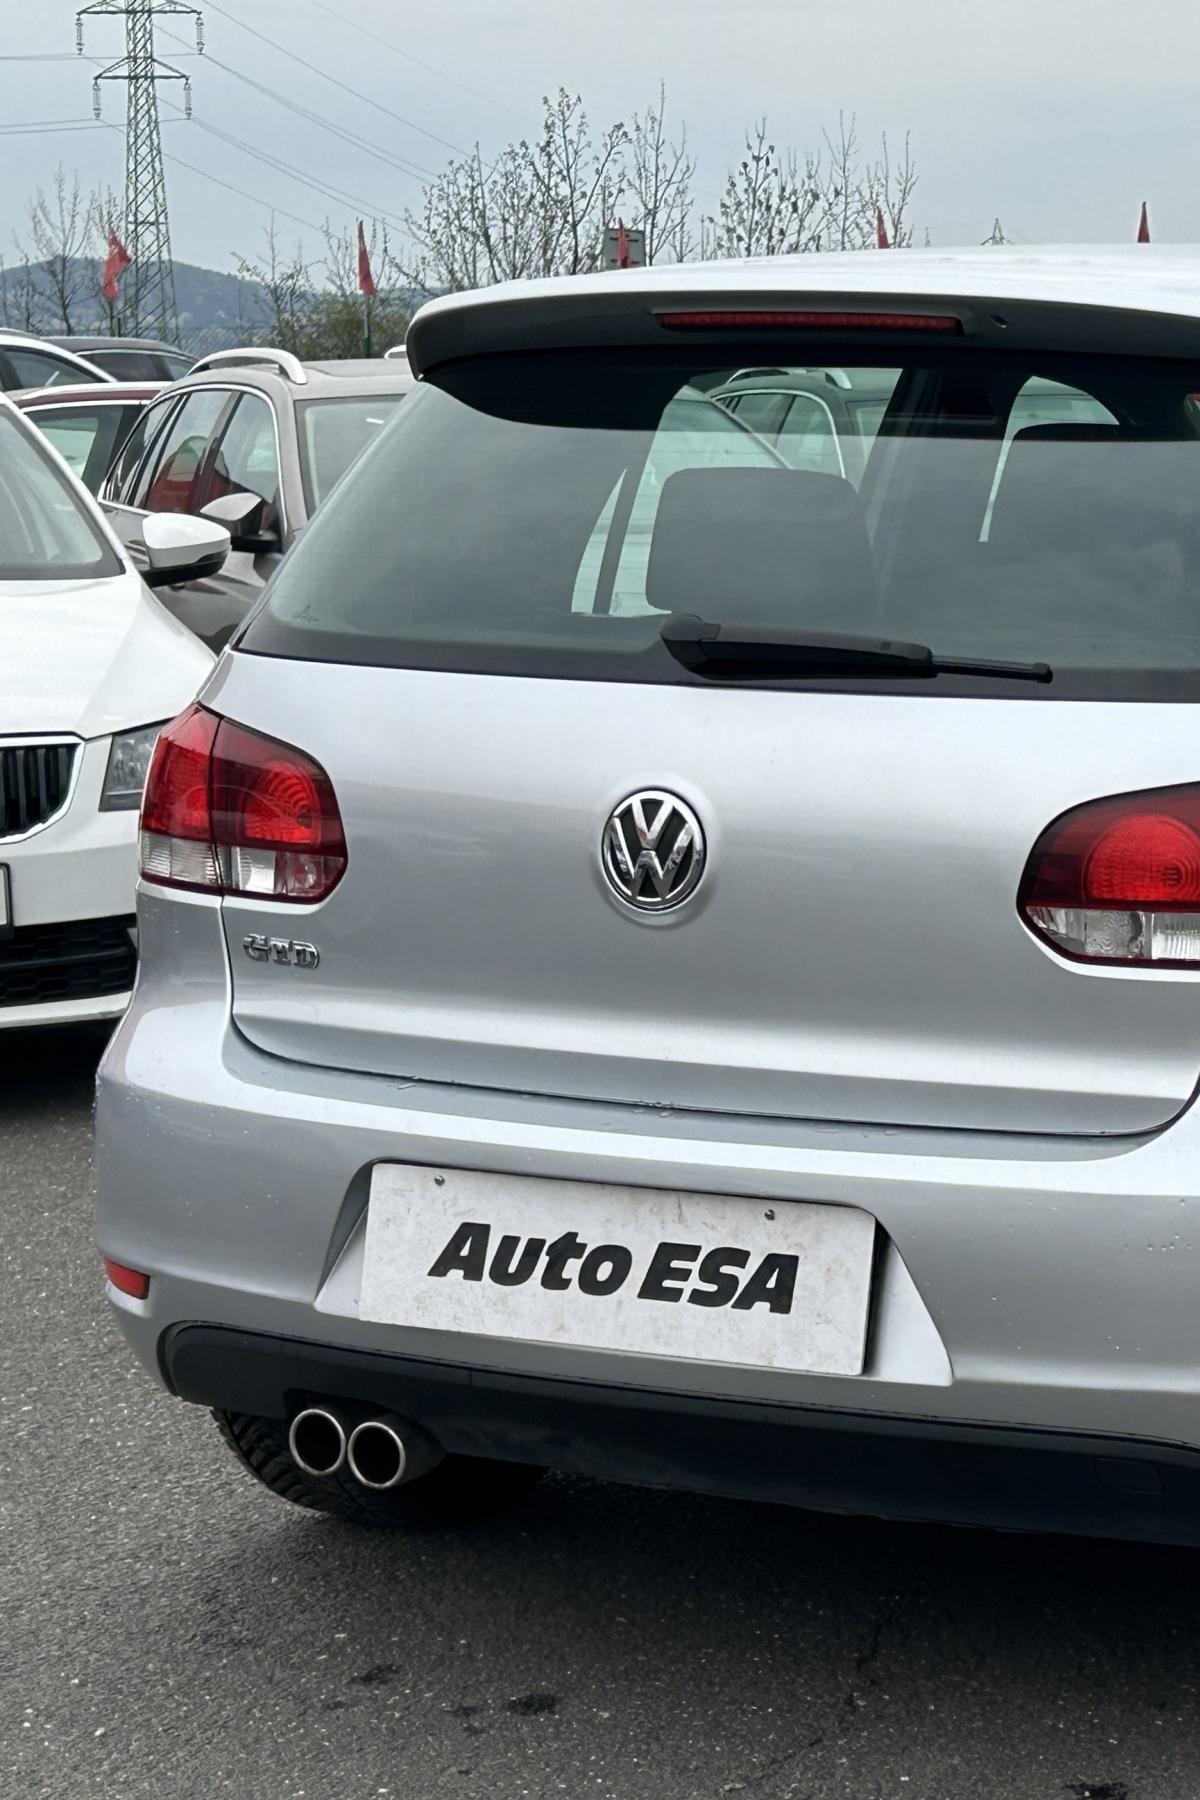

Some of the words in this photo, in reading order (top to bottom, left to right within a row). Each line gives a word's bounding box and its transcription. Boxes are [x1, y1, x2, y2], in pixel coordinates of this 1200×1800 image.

[243, 933, 320, 970] GTD
[427, 1221, 634, 1297] Auto
[637, 1241, 800, 1316] ESA
